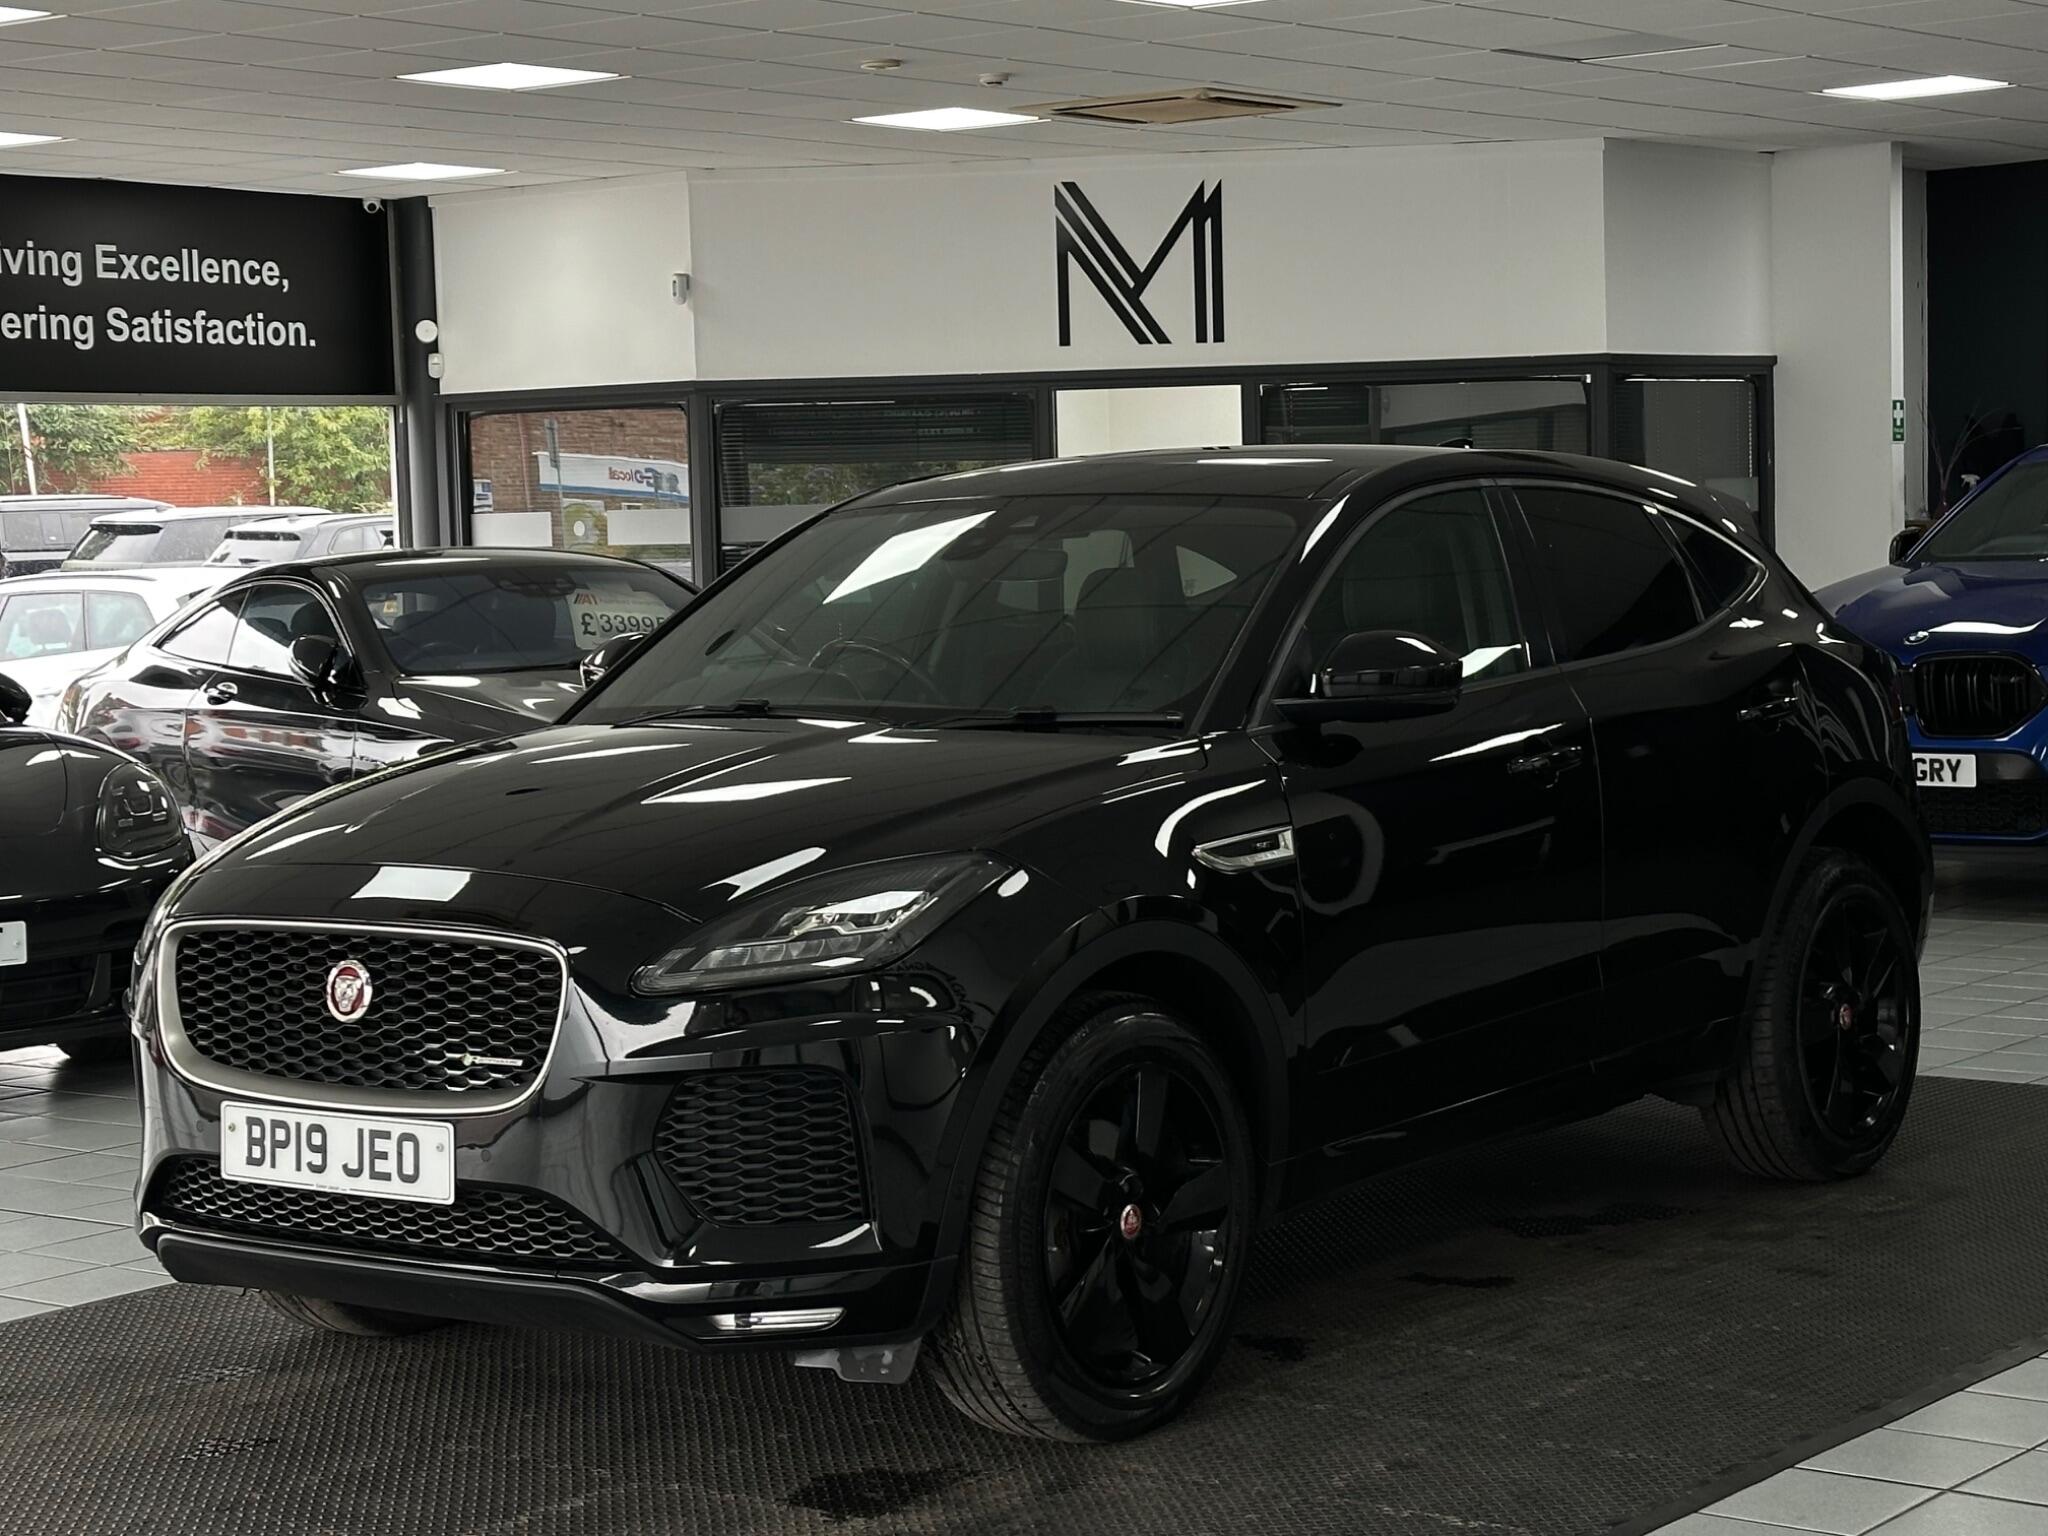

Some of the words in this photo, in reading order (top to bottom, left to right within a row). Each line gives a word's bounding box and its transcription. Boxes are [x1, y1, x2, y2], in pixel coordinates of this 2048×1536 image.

[95, 244, 289, 293] Excellence,
[106, 306, 316, 348] Satisfaction.
[1913, 757, 1962, 783] GRY
[245, 1116, 328, 1174] BP19
[341, 1127, 421, 1184] JEO
